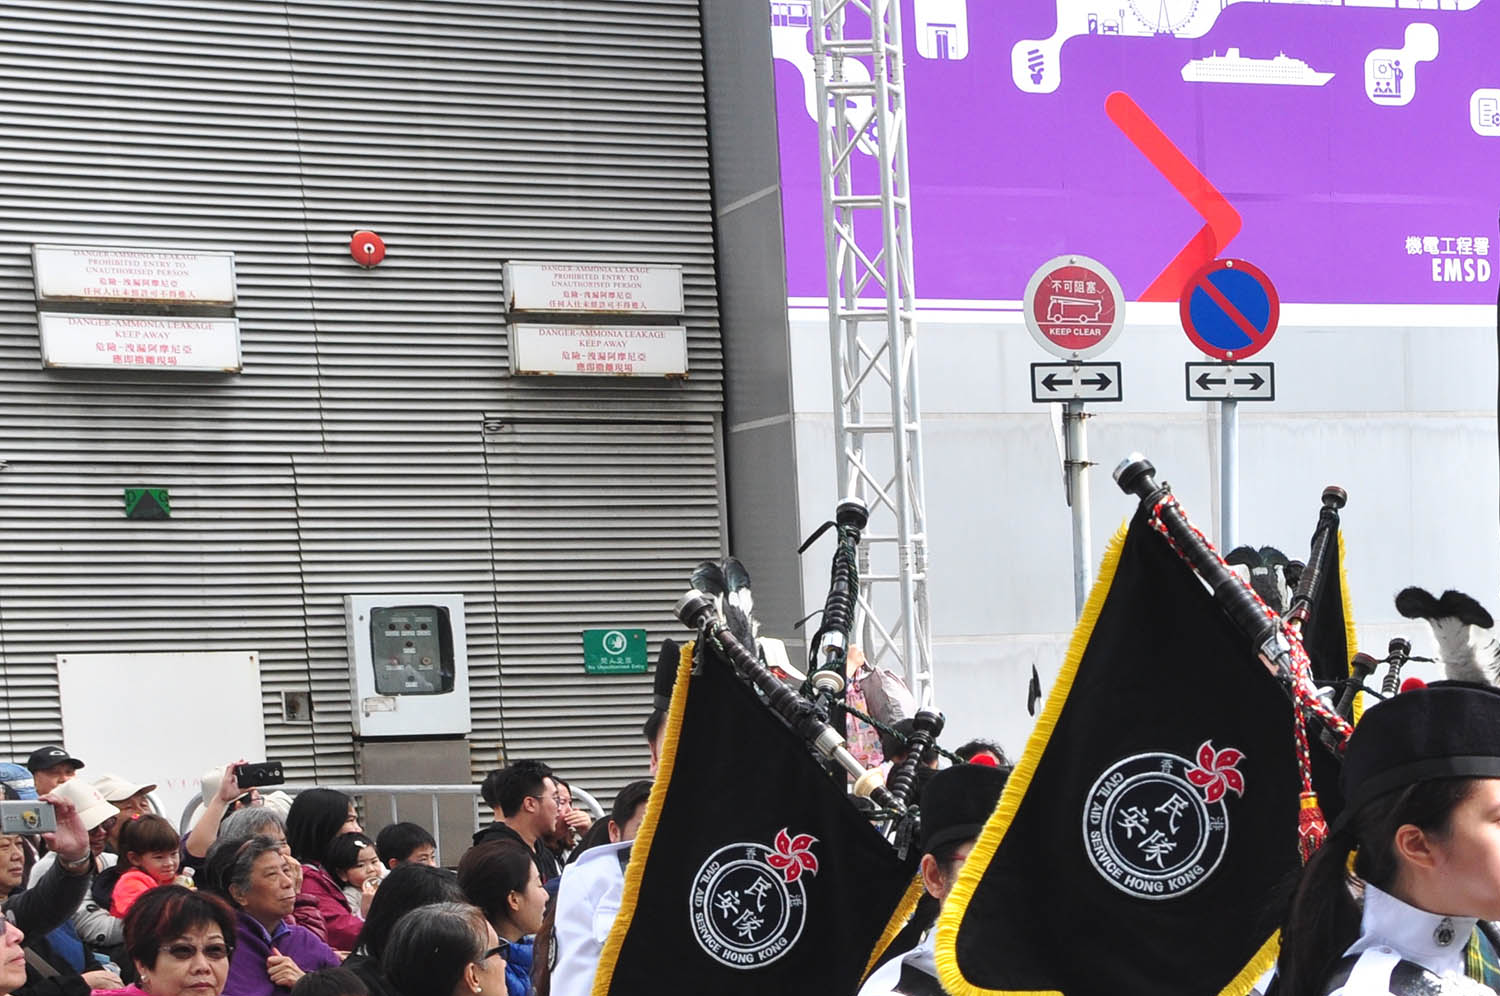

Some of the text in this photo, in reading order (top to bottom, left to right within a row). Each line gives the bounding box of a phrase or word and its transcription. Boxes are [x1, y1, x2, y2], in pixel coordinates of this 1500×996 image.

[1405, 236, 1490, 256] 機電工程署
[88, 259, 140, 267] PROHIBITED
[143, 260, 170, 268] ENTRY
[156, 268, 190, 277] PERSON
[1432, 257, 1491, 282] EMSD
[554, 273, 600, 281] PROHIBITED
[613, 281, 643, 289] PERSON
[1051, 279, 1097, 293] 不可阻塞
[167, 320, 215, 330] LEAKAGE
[115, 330, 171, 340] KEEP AWAY
[625, 330, 666, 339] LEAKAGE
[1049, 327, 1101, 336] KEEP CLEAR
[579, 340, 628, 349] KEEP AWAY
[1090, 772, 1205, 892] CIVIL AID SERVICE HONG KONG
[694, 860, 788, 964] CIVIL AID SERVICE HONG KONG
